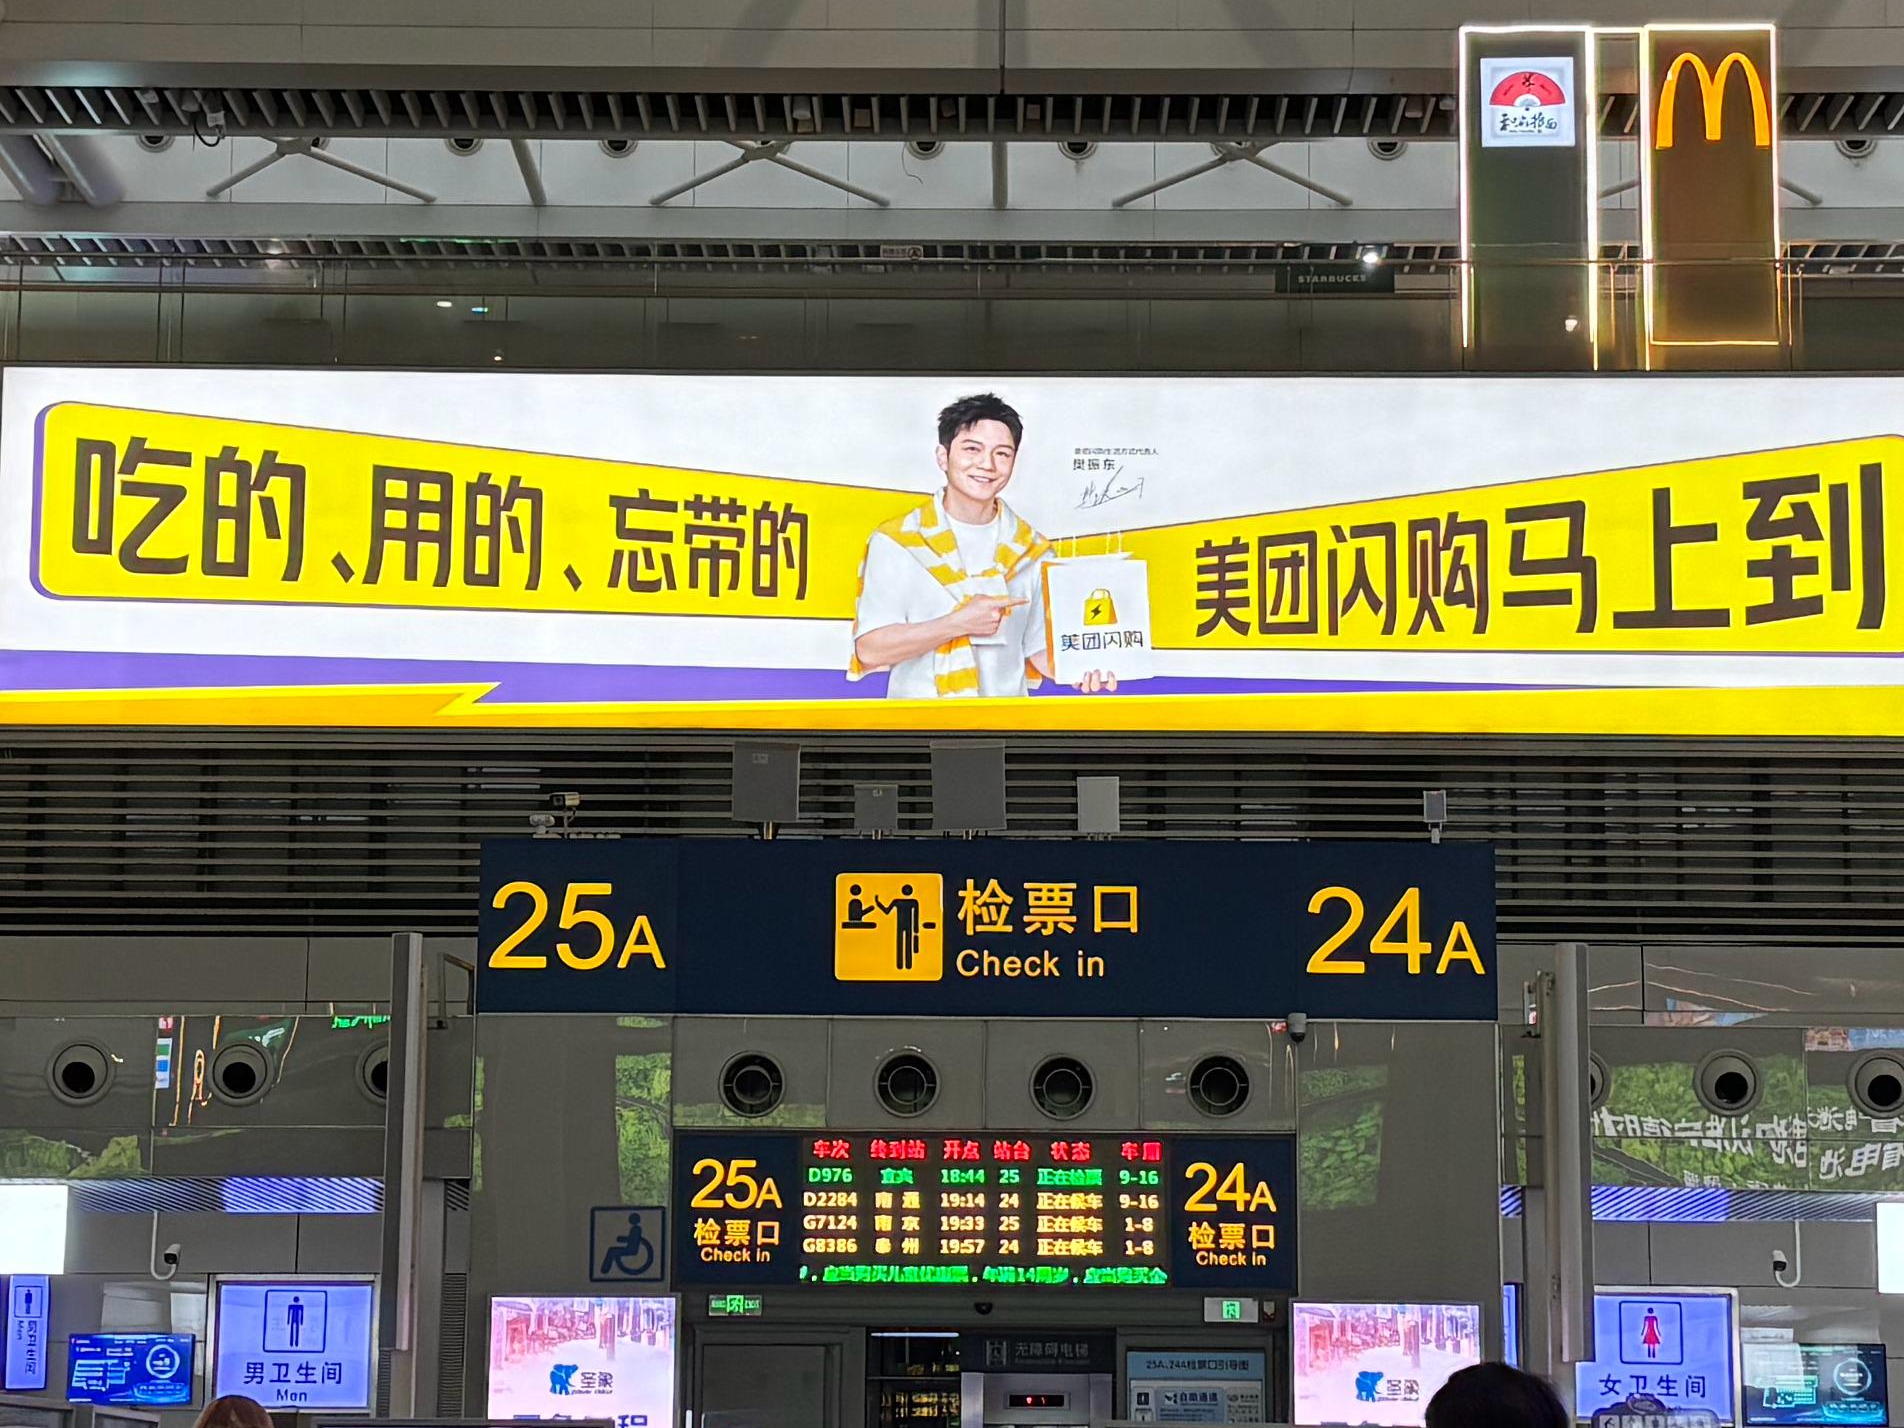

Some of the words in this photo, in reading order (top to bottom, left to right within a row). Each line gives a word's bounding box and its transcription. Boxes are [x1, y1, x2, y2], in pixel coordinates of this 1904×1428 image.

[1298, 274, 1367, 284] STARBUCKS
[71, 435, 809, 601] 吃的、用的、忘带的
[1194, 462, 1887, 639] 美团闪购马上到
[1060, 630, 1144, 653] 美团闪购
[957, 877, 1141, 937] 检票口
[487, 881, 667, 970] 25A
[1306, 885, 1487, 976] 24A
[956, 948, 1060, 978] Check
[1078, 948, 1105, 978] in
[813, 1139, 851, 1159] 车次
[870, 1140, 926, 1160] 终到站
[943, 1140, 981, 1160] 开点
[993, 1140, 1030, 1160] 站台
[1050, 1141, 1091, 1161] 状态
[690, 1158, 784, 1209] 25A
[808, 1168, 853, 1184] D976
[941, 1168, 985, 1184] 18:44
[998, 1168, 1020, 1184] 25
[1119, 1168, 1159, 1184] 9-16
[1184, 1162, 1278, 1213] 24A
[802, 1192, 858, 1208] D2284
[940, 1192, 985, 1208] 19:14
[998, 1192, 1020, 1208] 24
[1119, 1192, 1159, 1208] 9-16
[693, 1220, 780, 1247] 检票口
[802, 1215, 858, 1232] G7124
[940, 1215, 985, 1232] 19:33
[998, 1215, 1020, 1232] 25
[1124, 1215, 1154, 1232] 1-8
[1187, 1222, 1276, 1249] 检票口
[700, 1247, 751, 1263] Check
[755, 1247, 771, 1263] in
[940, 1238, 985, 1255] 19:57
[998, 1238, 1020, 1255] 24
[1124, 1238, 1154, 1255] 1-8
[1195, 1251, 1247, 1266] Check
[1251, 1251, 1267, 1266] in
[243, 1362, 343, 1386] 男卫生间
[1598, 1373, 1707, 1399] 女卫生间
[275, 1387, 309, 1403] Men
